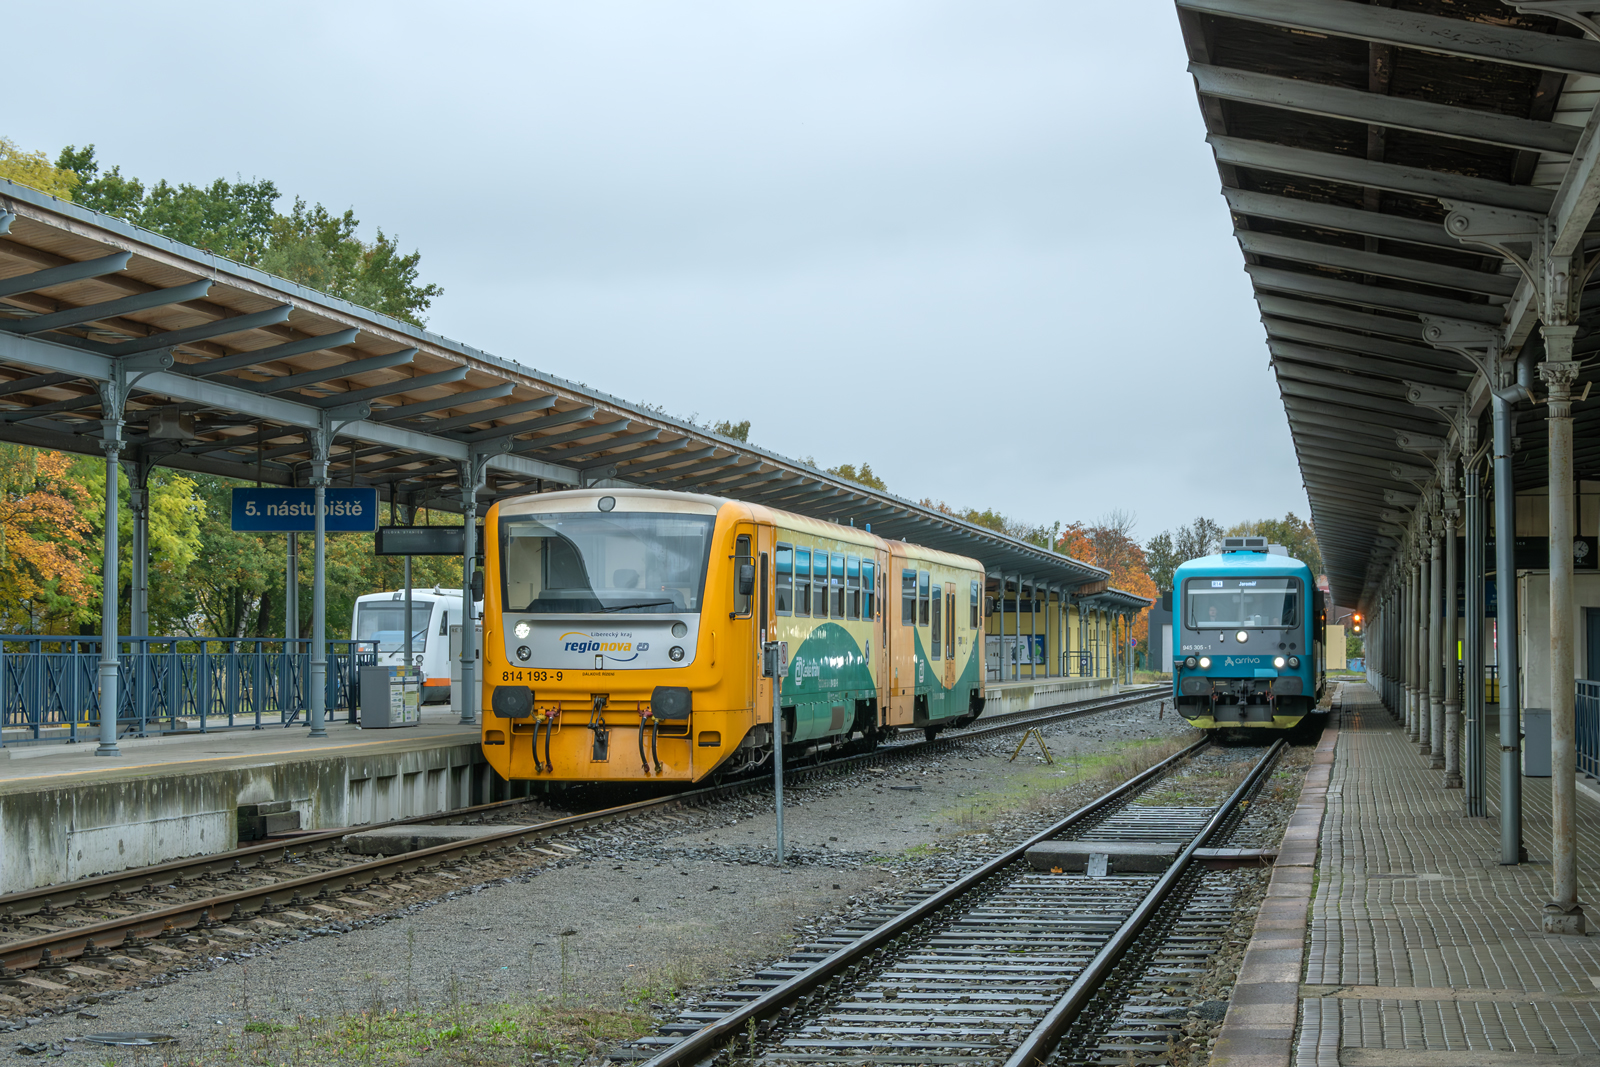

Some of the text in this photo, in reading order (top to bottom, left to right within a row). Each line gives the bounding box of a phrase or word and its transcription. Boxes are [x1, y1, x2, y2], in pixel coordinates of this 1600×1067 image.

[245, 501, 261, 516] 5.
[564, 640, 632, 653] regionova
[1235, 656, 1261, 664] arriva
[502, 671, 523, 682] 814
[527, 671, 547, 682] 193
[556, 671, 563, 682] 9
